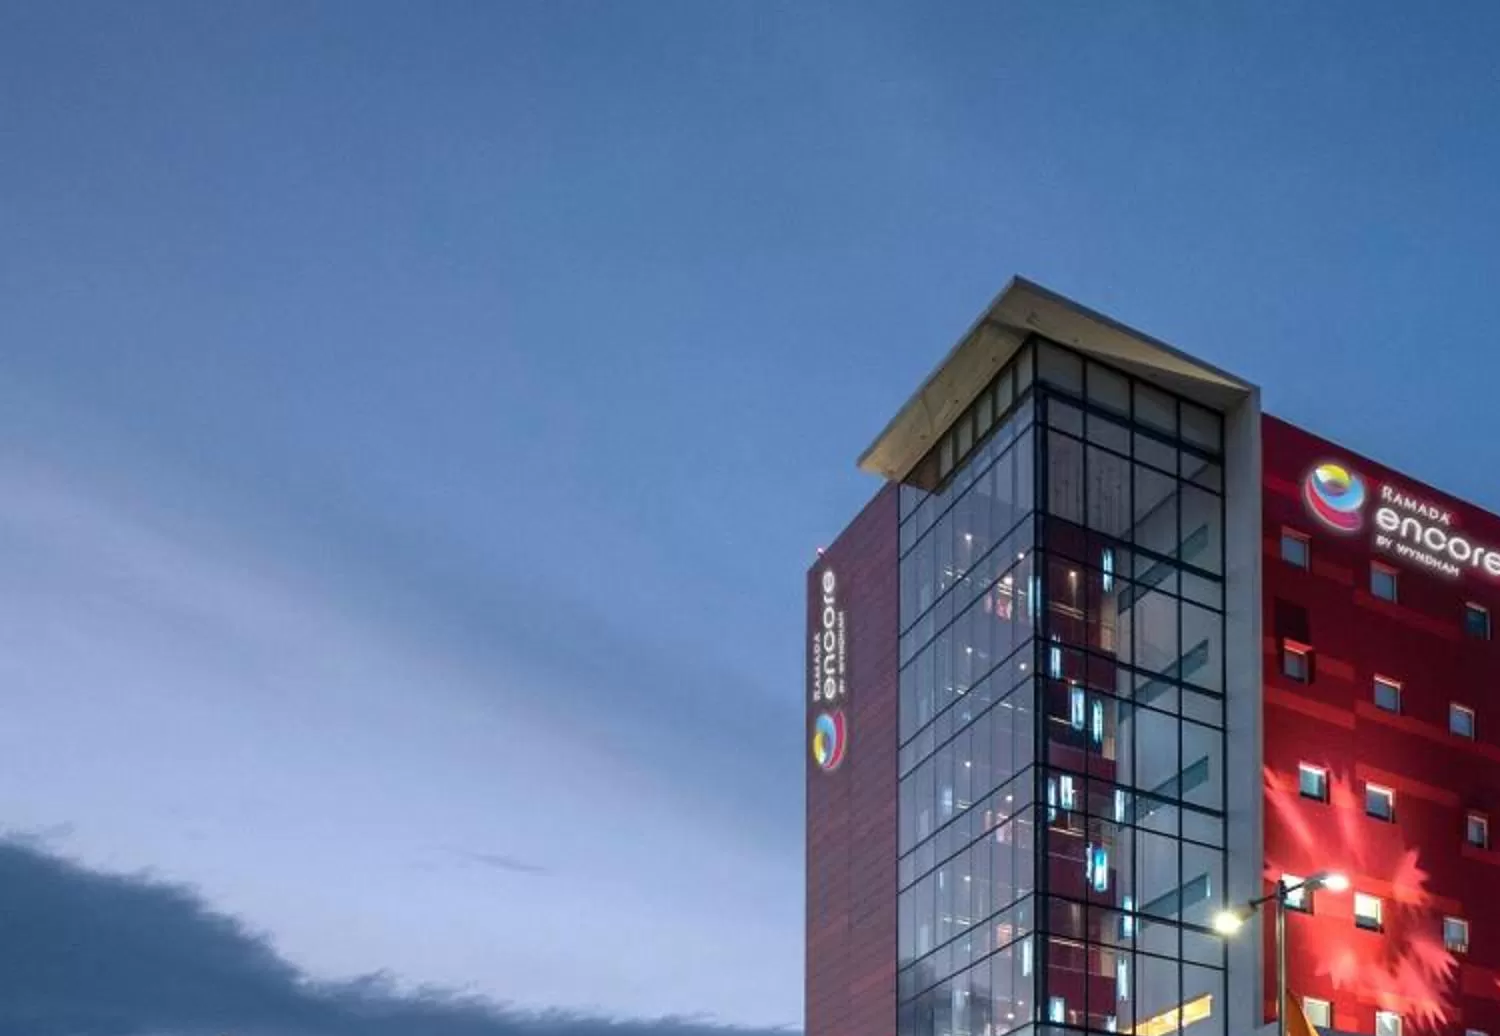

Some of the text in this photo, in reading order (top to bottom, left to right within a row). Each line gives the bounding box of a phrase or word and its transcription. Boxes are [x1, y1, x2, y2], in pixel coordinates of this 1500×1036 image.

[1381, 485, 1452, 525] RAMADA
[1376, 534, 1460, 576] BY WYNDHAM
[822, 570, 836, 700] encore
[813, 632, 821, 701] RAMADA
